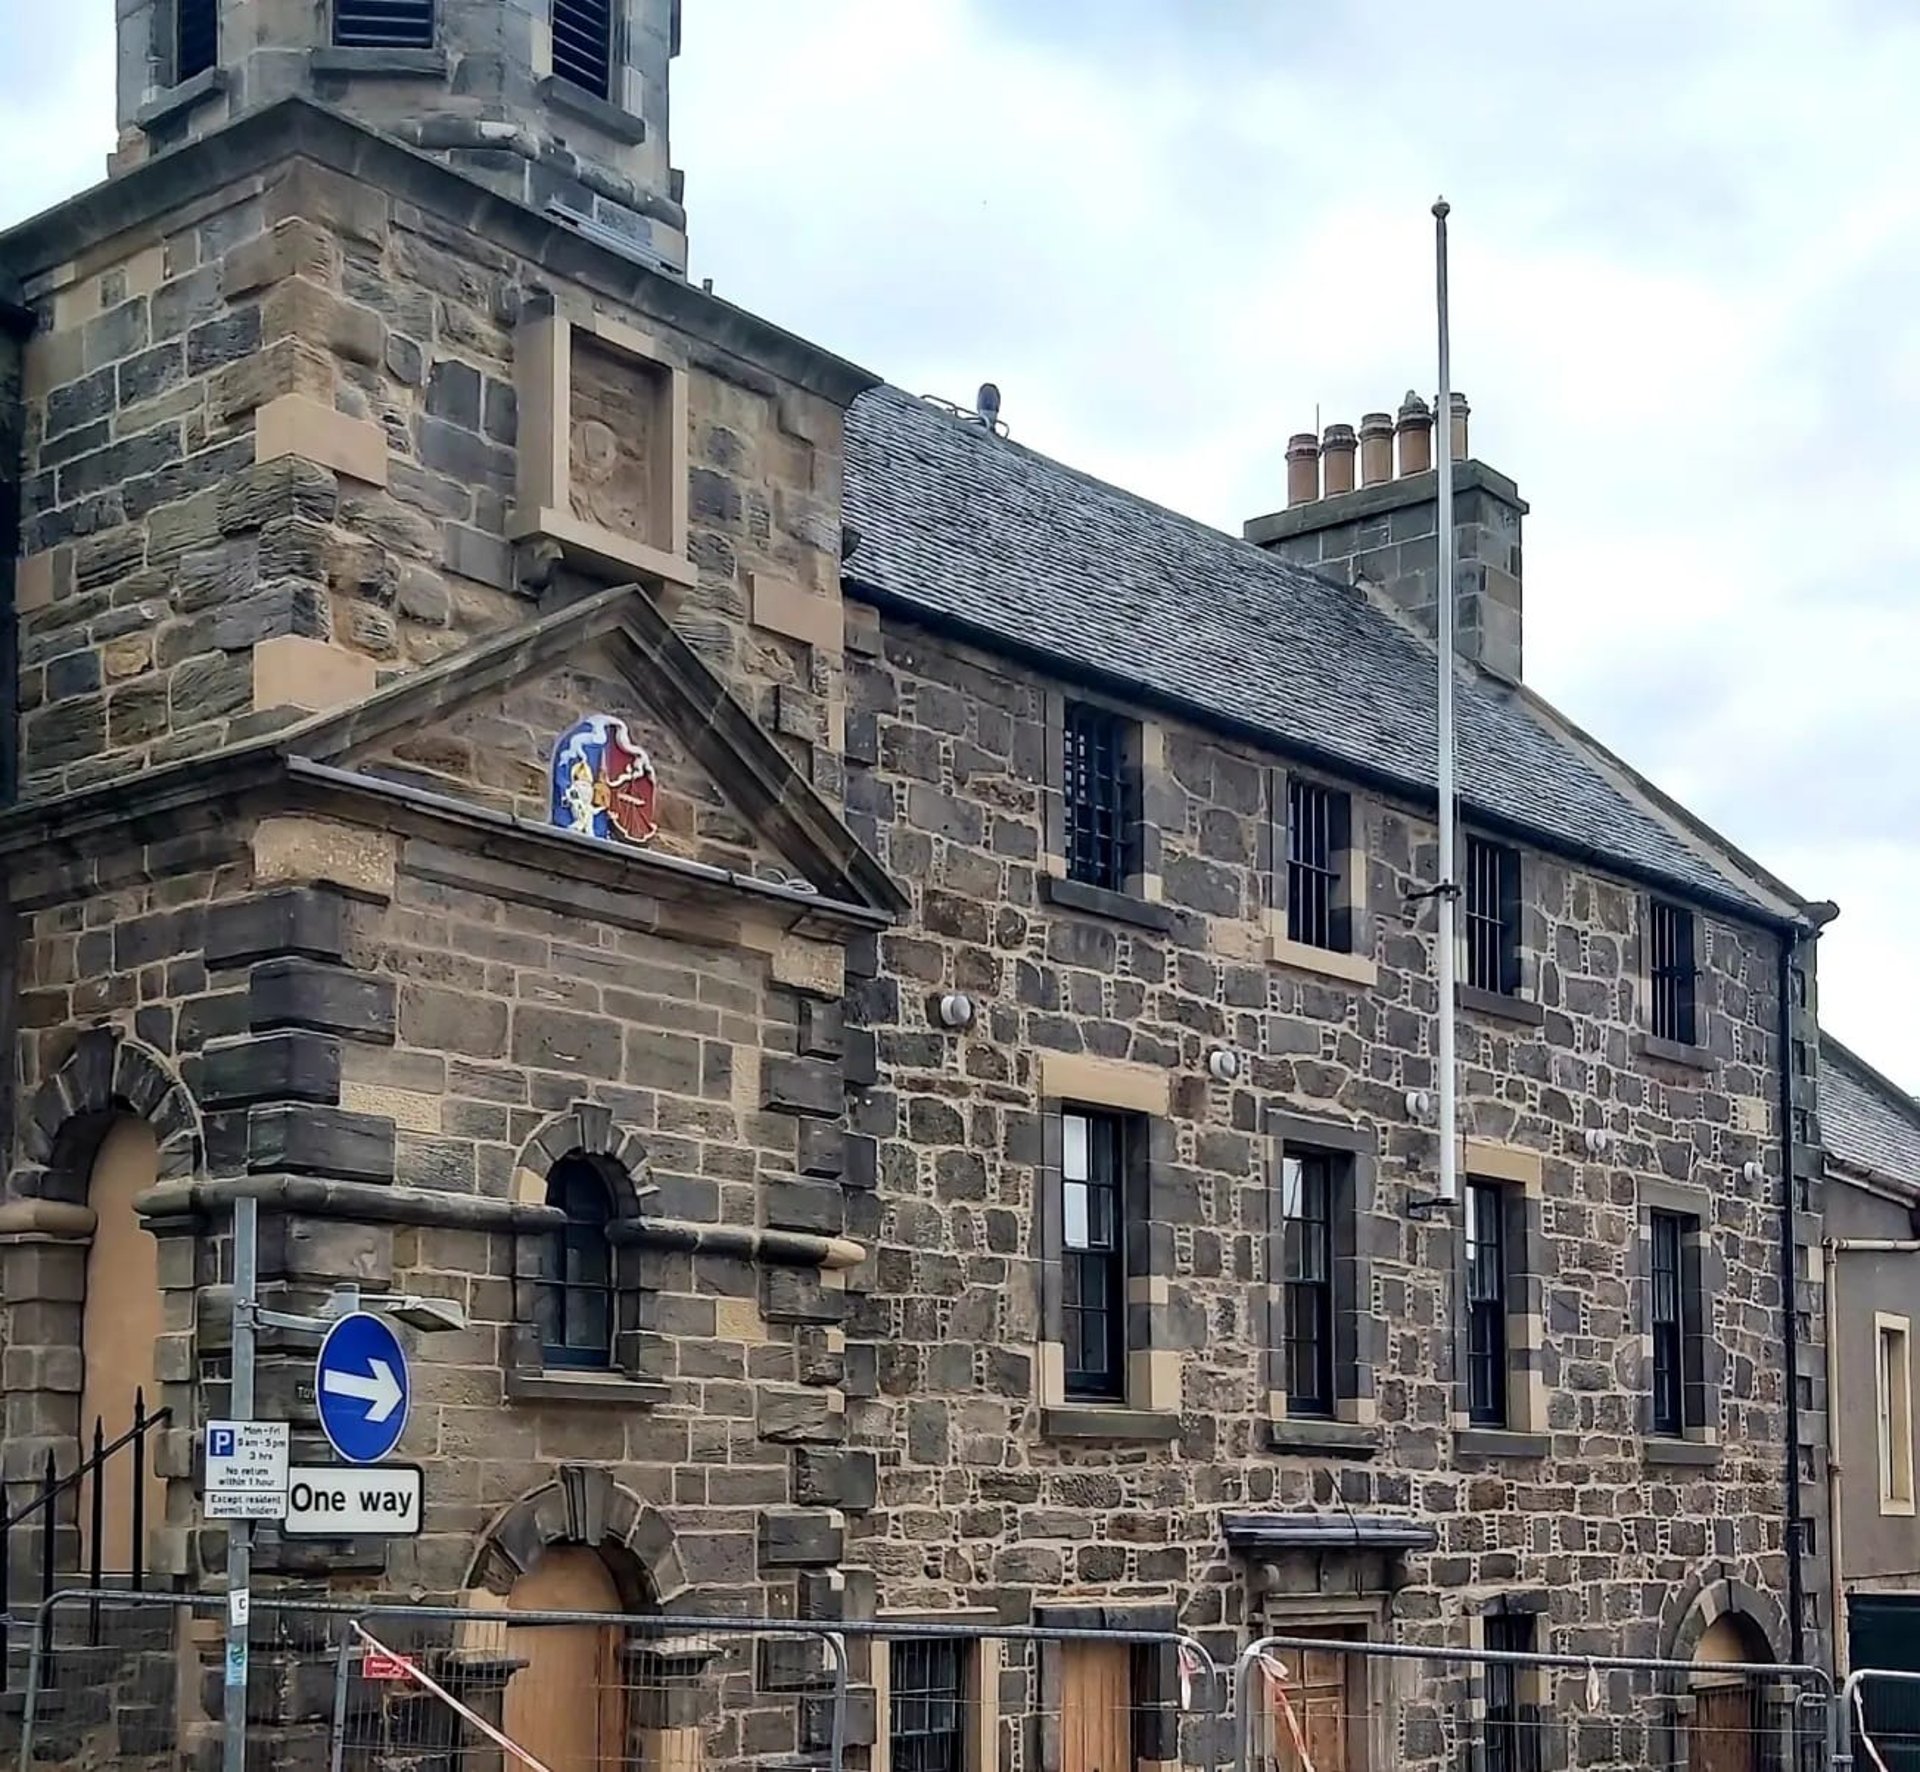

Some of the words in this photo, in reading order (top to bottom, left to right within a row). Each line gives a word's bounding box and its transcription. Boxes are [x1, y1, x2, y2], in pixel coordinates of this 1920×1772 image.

[215, 1431, 231, 1454] P
[226, 1466, 239, 1475] No
[241, 1466, 269, 1475] return
[218, 1477, 246, 1485] within
[255, 1477, 275, 1486] hour
[211, 1494, 242, 1504] Except
[245, 1494, 281, 1504] resident
[291, 1483, 346, 1512] One
[359, 1491, 412, 1517] way
[212, 1506, 242, 1515] permit
[246, 1506, 278, 1515] holders
